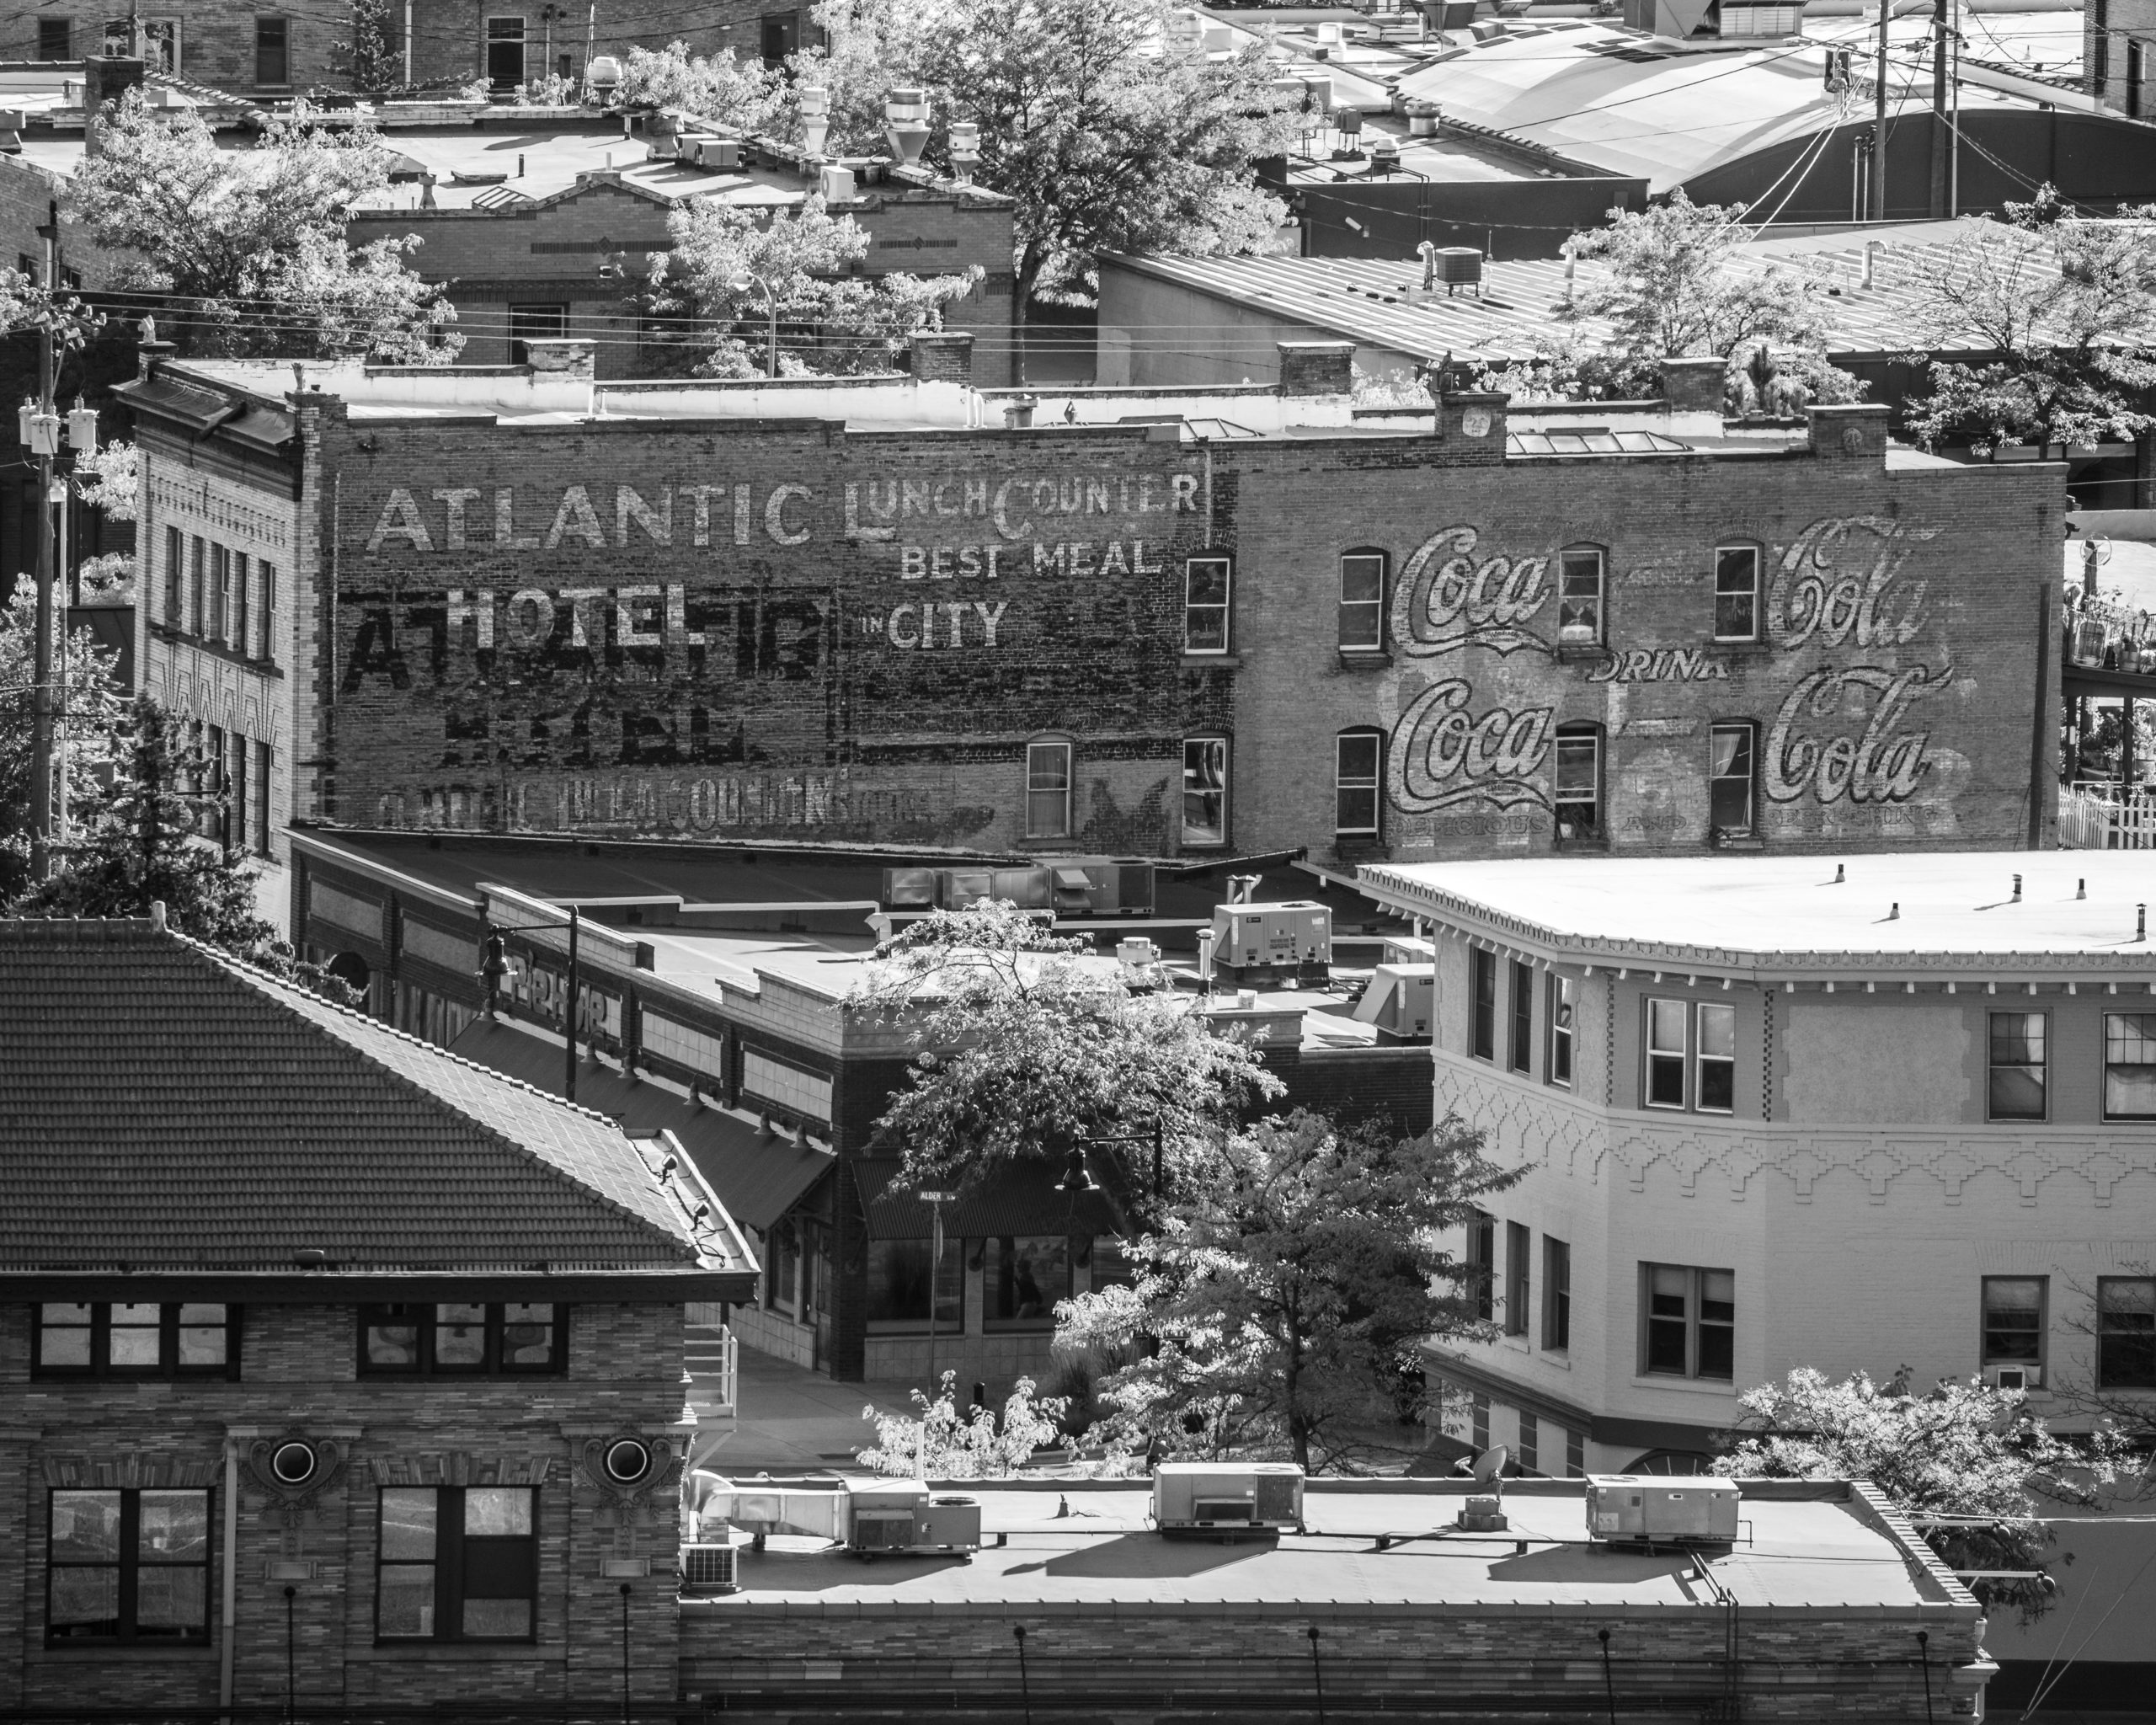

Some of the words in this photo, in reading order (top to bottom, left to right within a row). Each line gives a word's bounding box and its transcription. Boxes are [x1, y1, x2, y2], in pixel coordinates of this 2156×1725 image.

[366, 483, 813, 552] ATLANTIC
[844, 478, 987, 541] LUNCH
[993, 473, 1200, 540] COUNTER
[900, 543, 1003, 581] BEST
[1033, 541, 1164, 577] MEAL
[1389, 522, 1555, 660] Coca
[1768, 513, 1947, 651] Cola
[446, 583, 706, 649] HOTEL
[861, 616, 883, 634] IN
[888, 600, 1010, 649] CITY
[1386, 677, 1556, 815] Coca
[1766, 663, 1954, 804] Cola
[920, 1191, 942, 1200] ALDER
